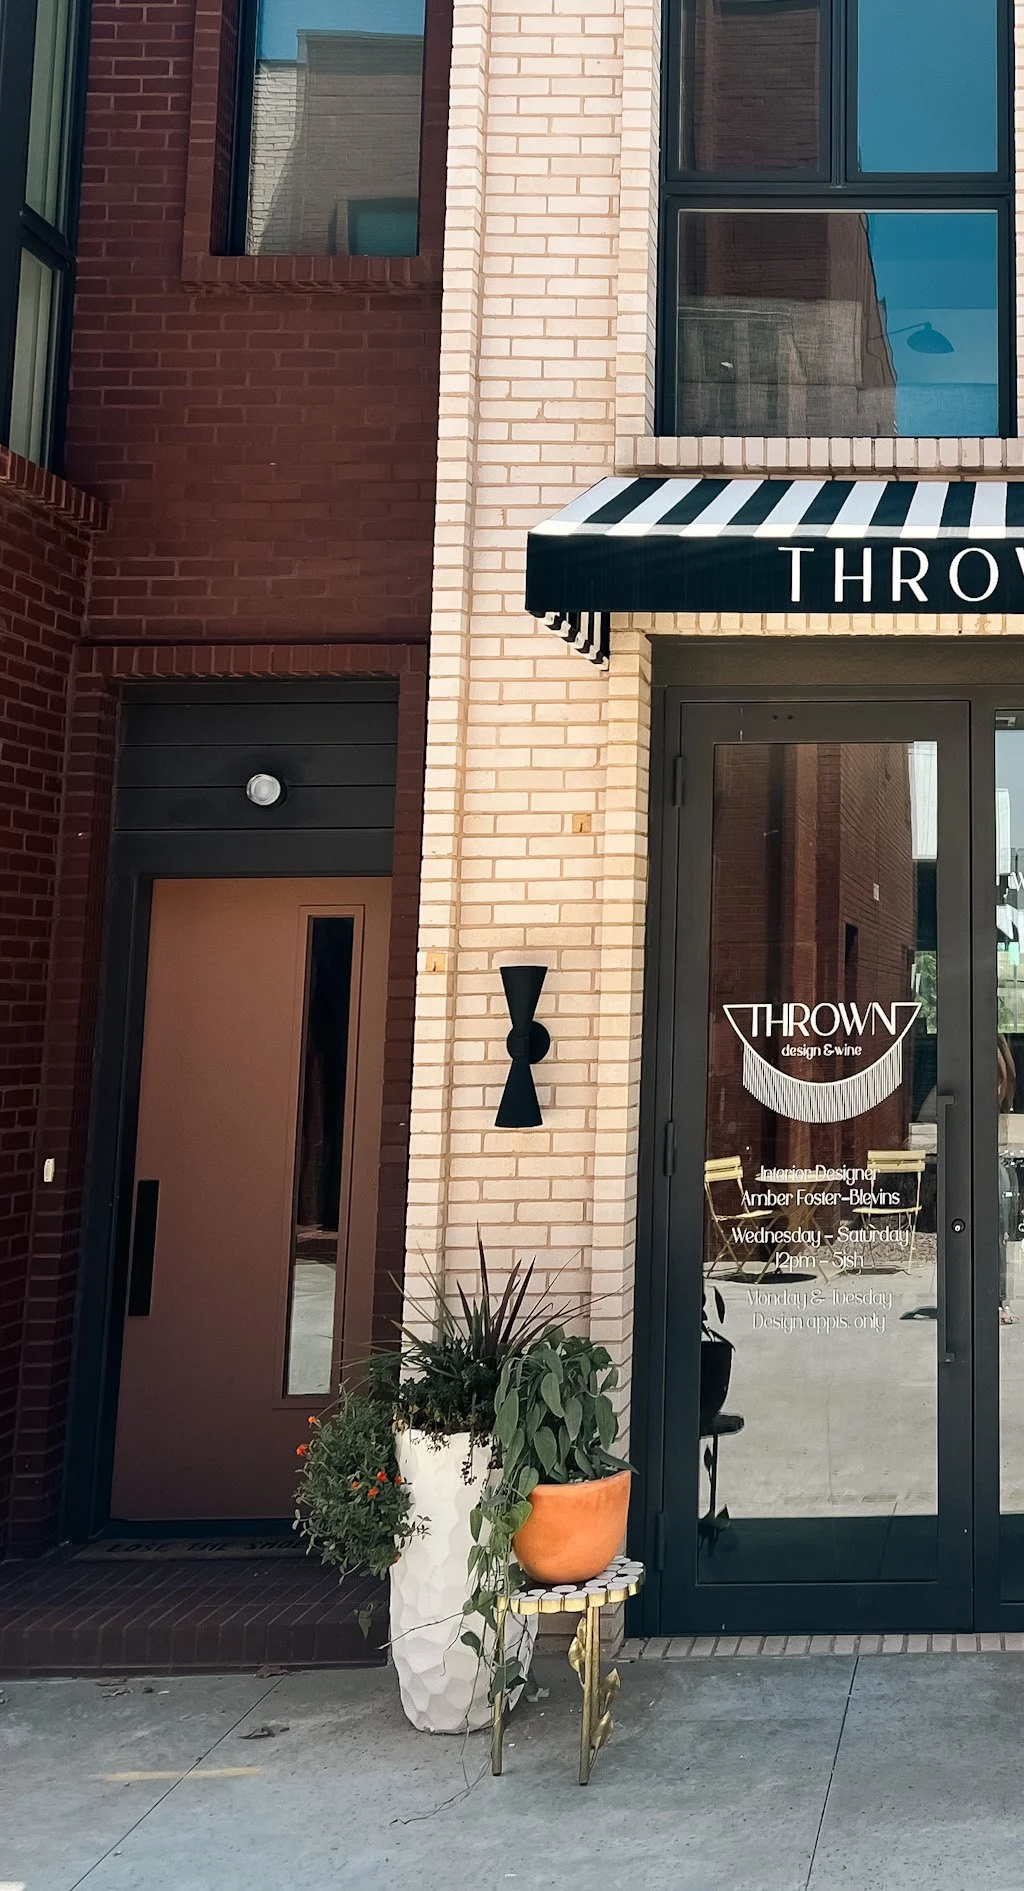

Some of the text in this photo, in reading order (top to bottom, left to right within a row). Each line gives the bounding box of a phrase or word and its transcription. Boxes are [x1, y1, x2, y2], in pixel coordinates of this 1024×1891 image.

[750, 1002, 898, 1038] THROWN
[781, 1043, 822, 1060] design
[760, 1164, 881, 1185] Interior Designer
[740, 1189, 795, 1207] Amber
[732, 1226, 821, 1246] Wednesday
[837, 1226, 910, 1247] Saturday
[775, 1251, 816, 1272] 12pm
[832, 1250, 864, 1269] 5ish
[746, 1288, 893, 1311] Monday & Tuesday
[752, 1312, 804, 1332] Design
[854, 1311, 886, 1335] only
